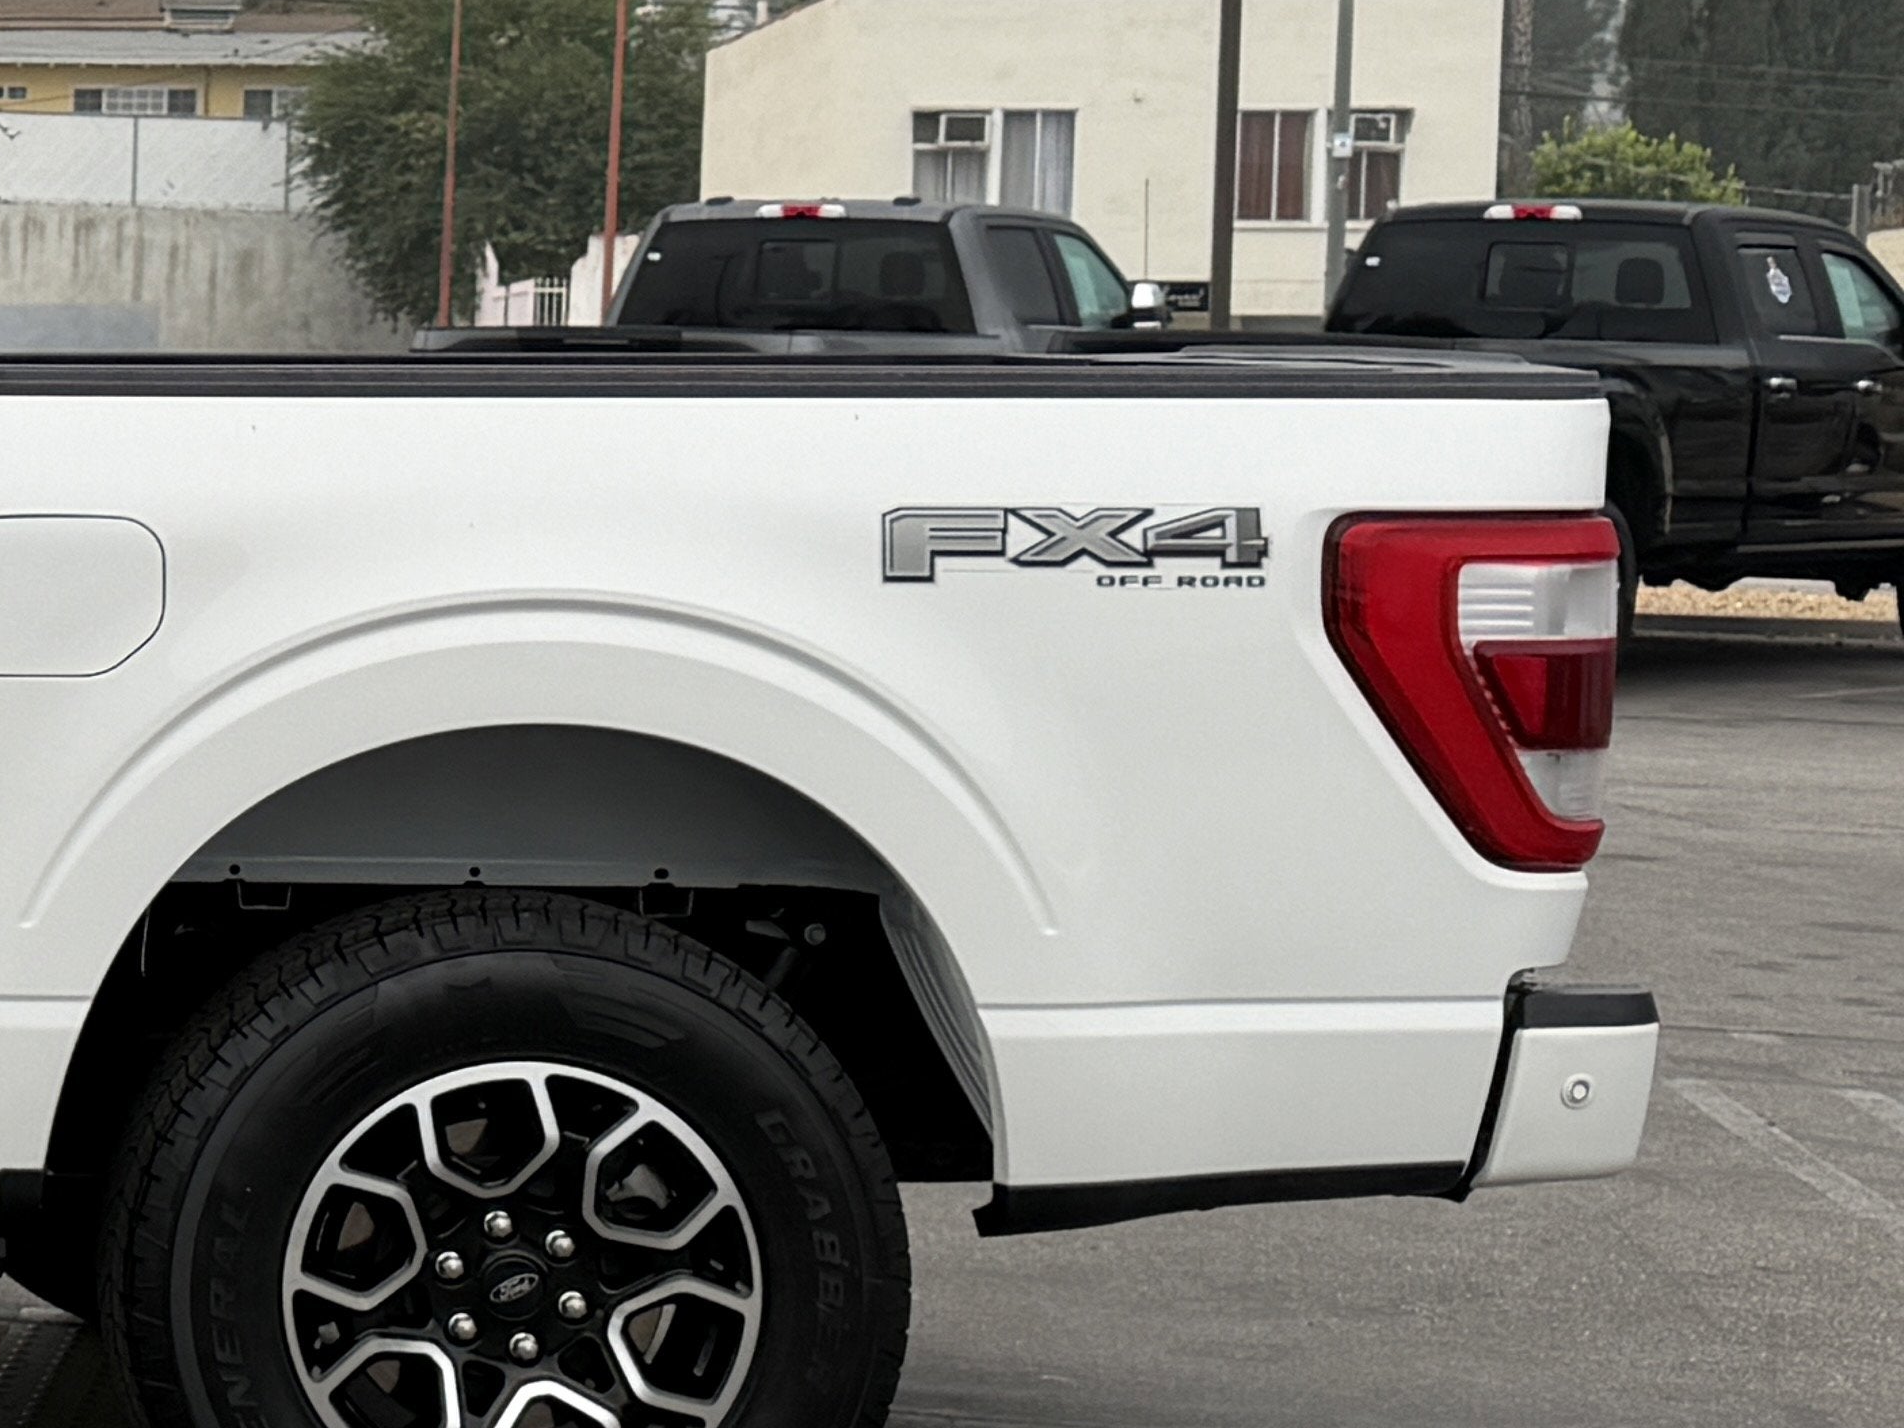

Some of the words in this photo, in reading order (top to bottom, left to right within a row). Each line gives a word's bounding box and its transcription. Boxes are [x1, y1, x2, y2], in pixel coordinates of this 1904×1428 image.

[881, 506, 1269, 582] FX4
[1096, 575, 1162, 588] OFF
[1176, 575, 1267, 588] ROAD
[755, 1109, 845, 1387] GRABBE
